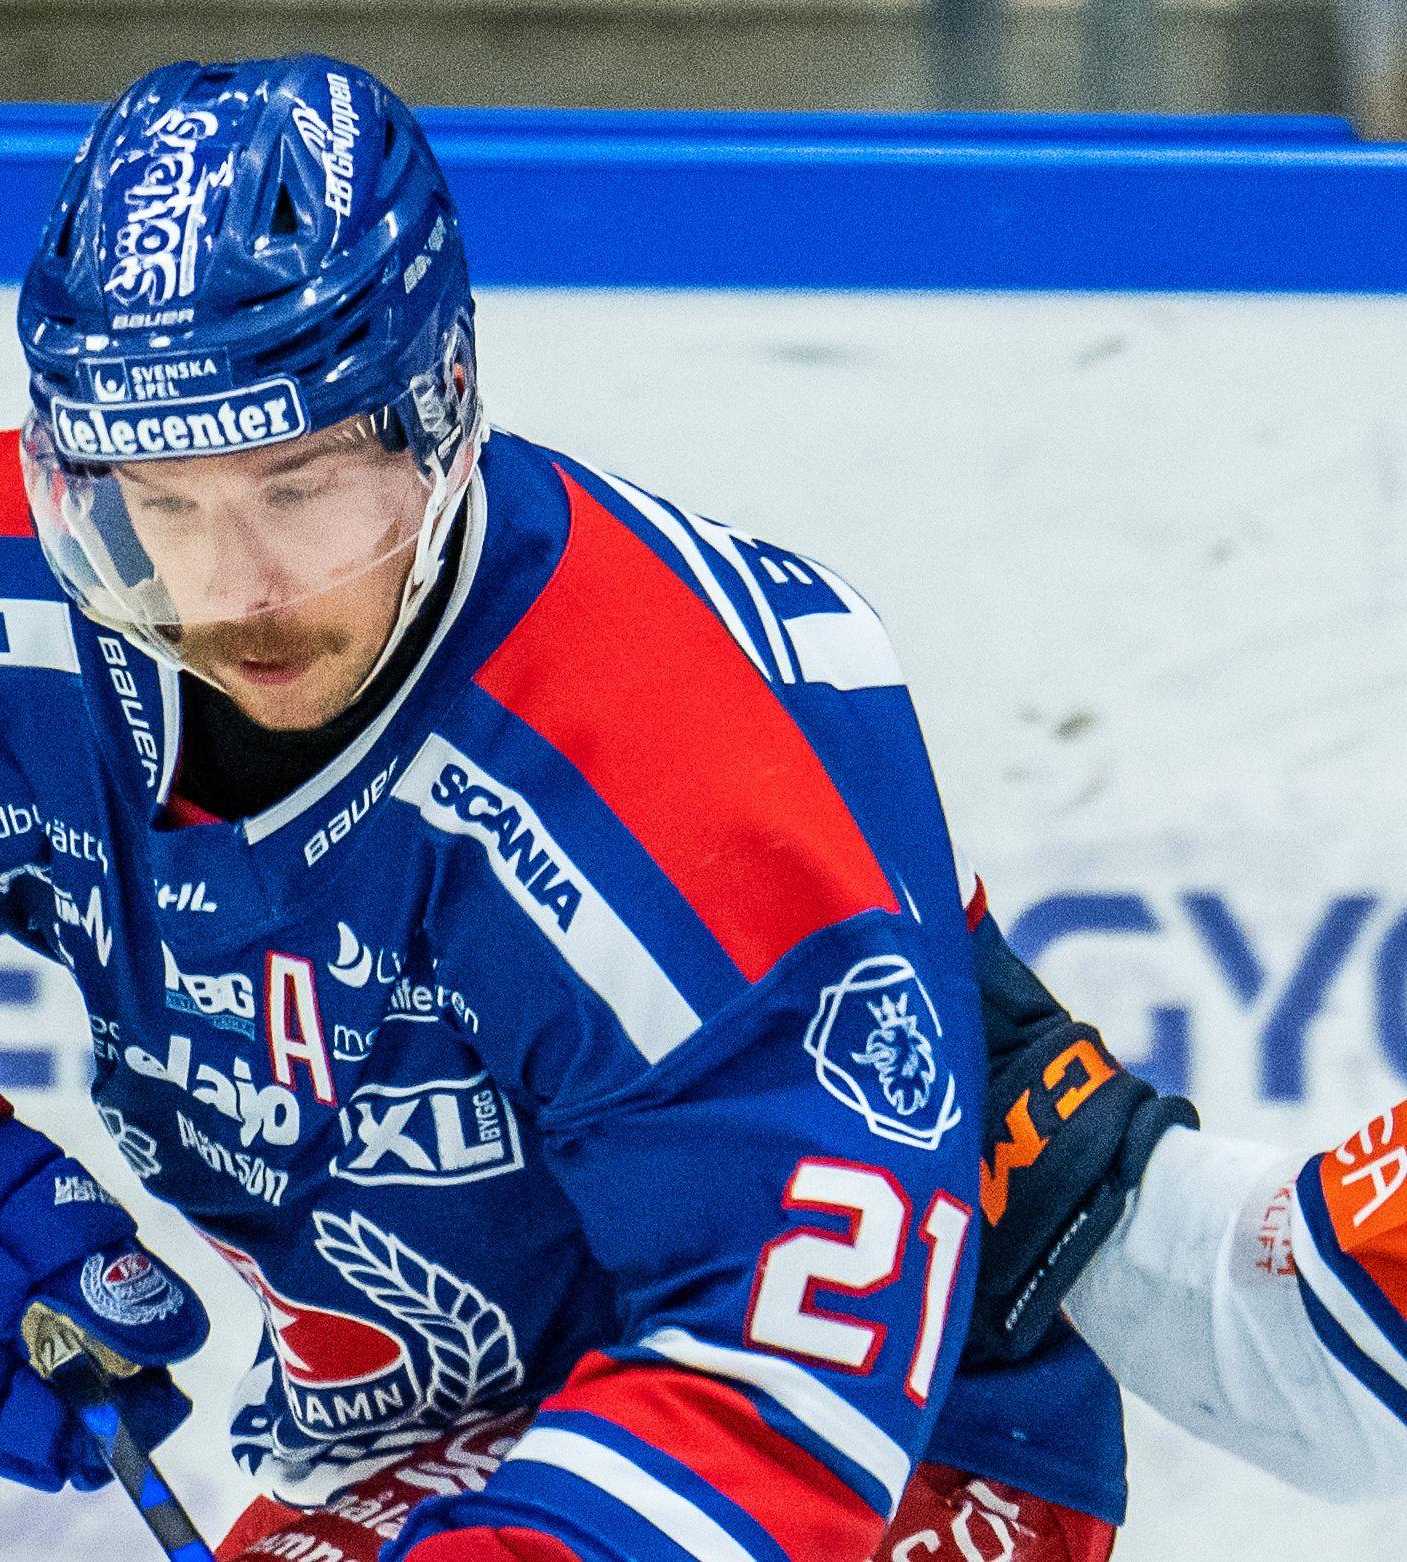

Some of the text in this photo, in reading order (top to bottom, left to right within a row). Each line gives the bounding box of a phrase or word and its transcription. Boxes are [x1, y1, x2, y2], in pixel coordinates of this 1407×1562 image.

[131, 358, 217, 383] SVENSKA
[134, 382, 180, 401] SPEL
[59, 396, 291, 454] telecenter
[430, 762, 591, 933] SCANIA
[265, 948, 339, 1108] A
[348, 1094, 505, 1172] XL
[745, 1156, 973, 1409] 21
